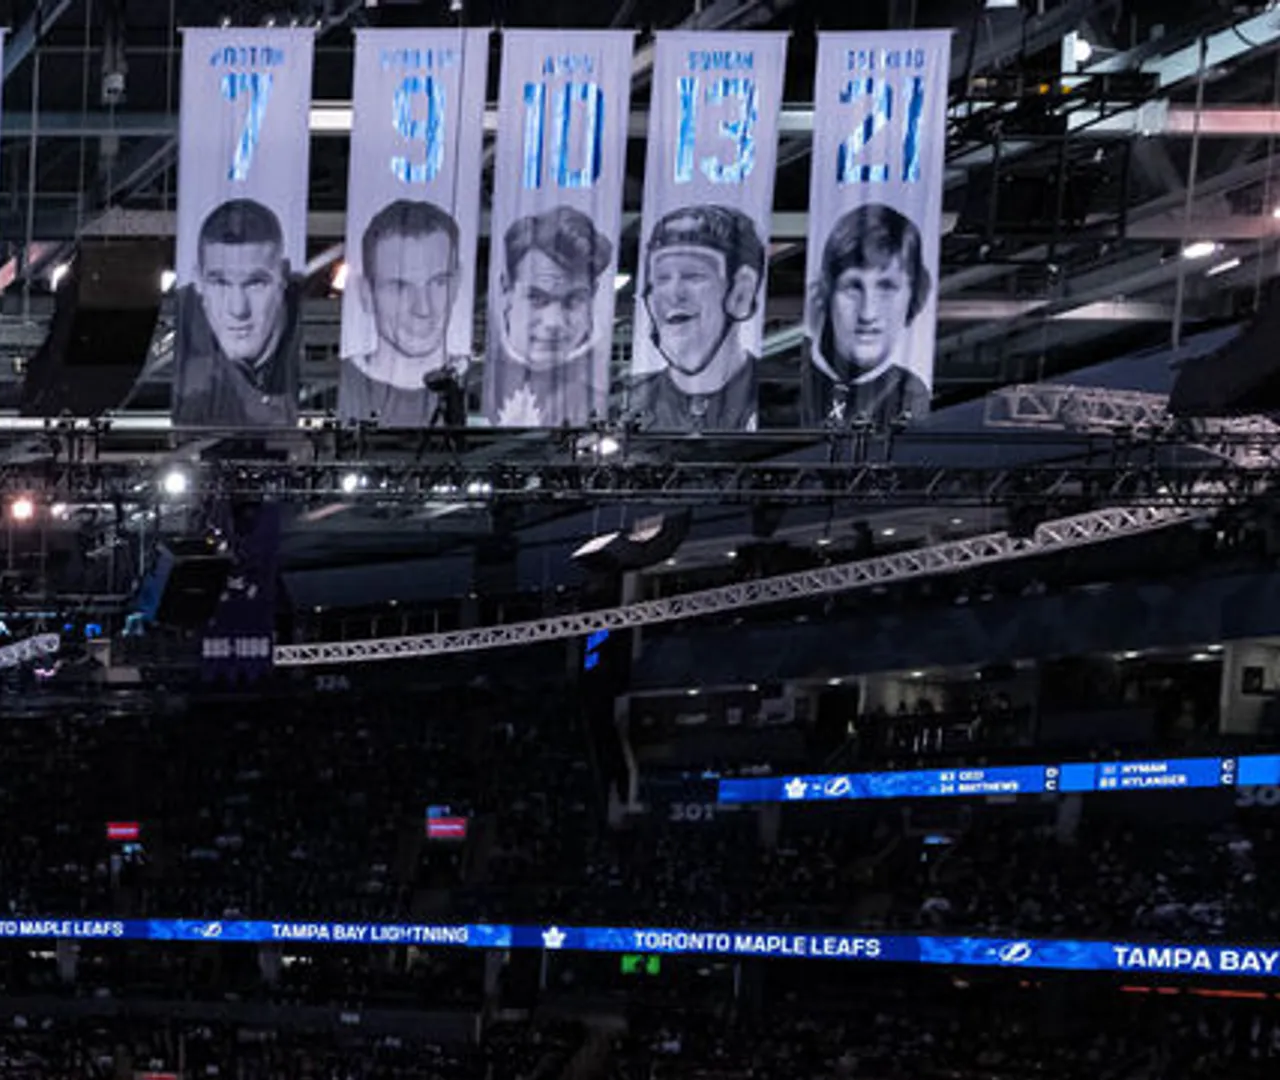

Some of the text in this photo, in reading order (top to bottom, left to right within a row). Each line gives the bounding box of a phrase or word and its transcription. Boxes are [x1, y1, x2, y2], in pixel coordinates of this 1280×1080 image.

[221, 74, 274, 182] 7
[392, 76, 447, 183] 9
[523, 82, 604, 188] 10
[675, 77, 757, 184] 13
[837, 76, 924, 184] 21
[20, 921, 71, 935] MAPLE
[75, 921, 124, 937] LEAFS
[272, 923, 468, 943] TAMPA BAY LIGHTNING
[634, 930, 881, 958] TORONTO MAPLE LEAFS
[1113, 945, 1279, 972] TAMPA BAY
